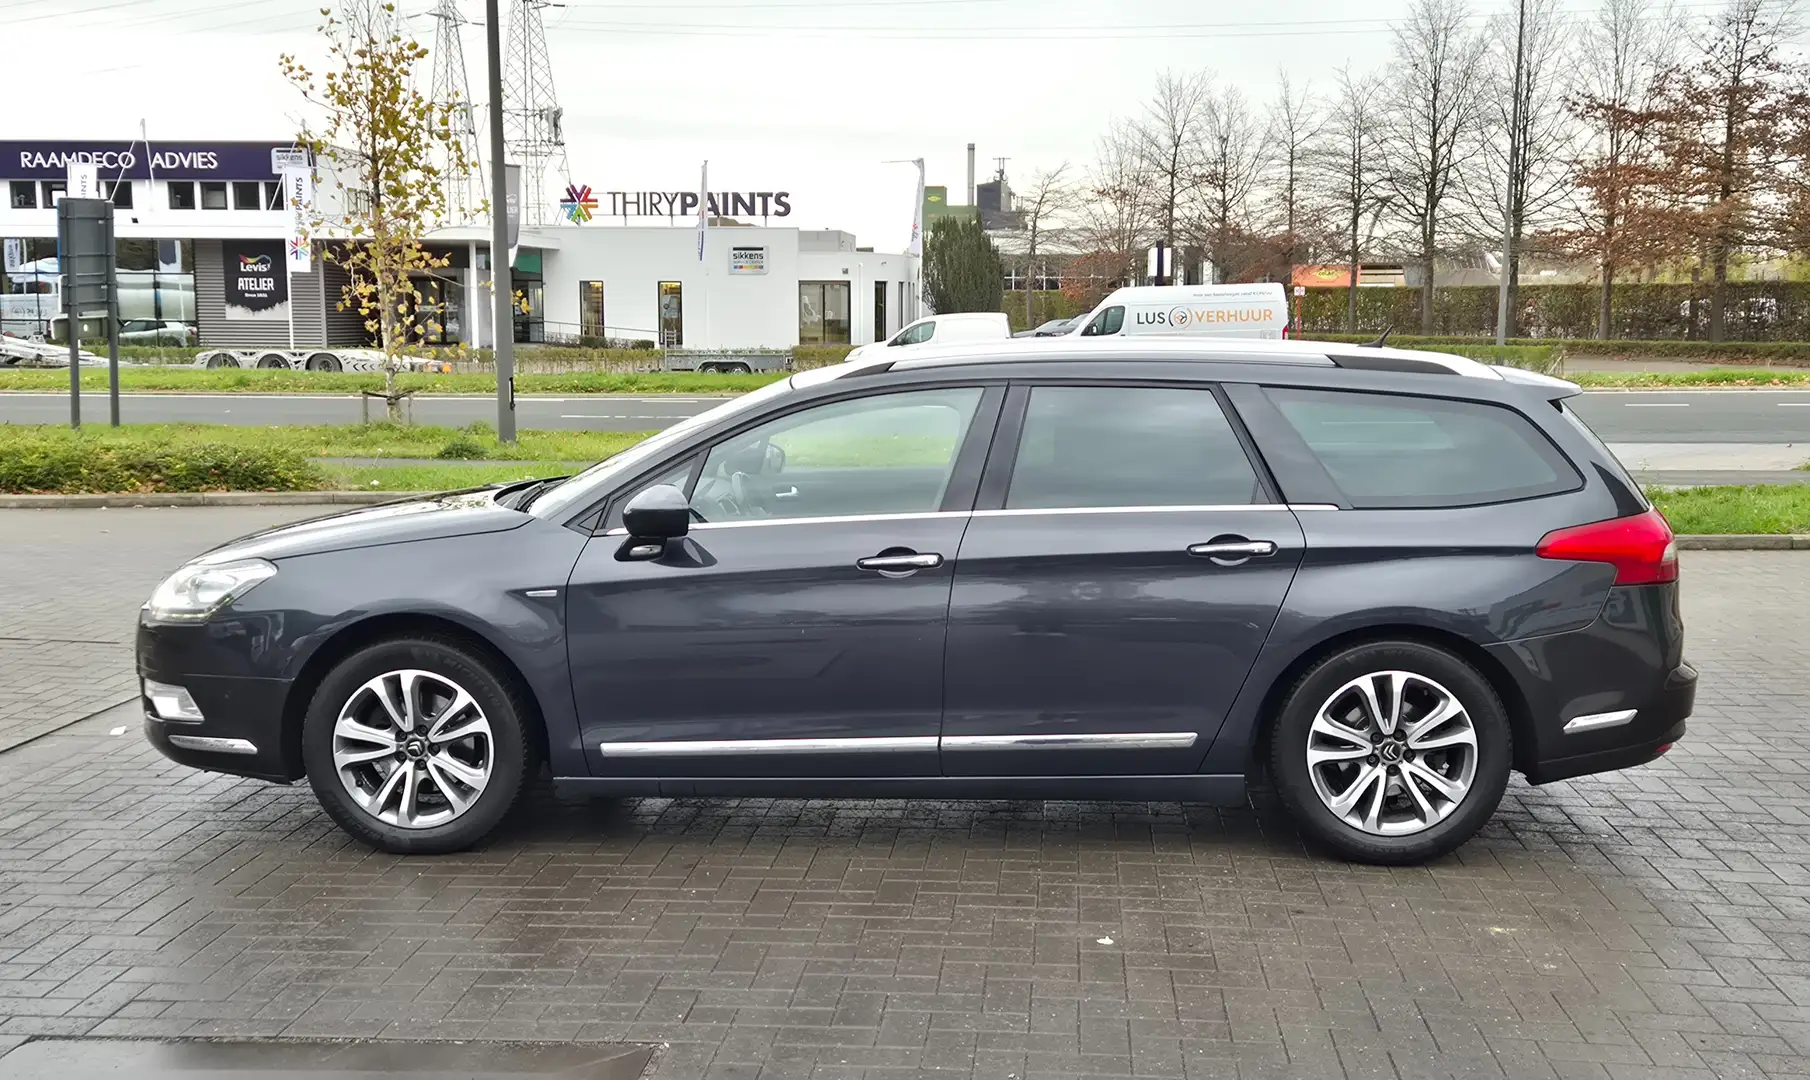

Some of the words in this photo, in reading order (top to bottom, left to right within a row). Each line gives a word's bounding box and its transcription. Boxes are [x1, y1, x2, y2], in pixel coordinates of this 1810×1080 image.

[20, 151, 135, 169] RAAMDECO
[151, 151, 218, 169] ADVIES
[733, 252, 764, 260] sikkens
[238, 277, 274, 291] ATELIER
[1137, 312, 1165, 324] LUS
[1195, 309, 1273, 323] VERHUUR
